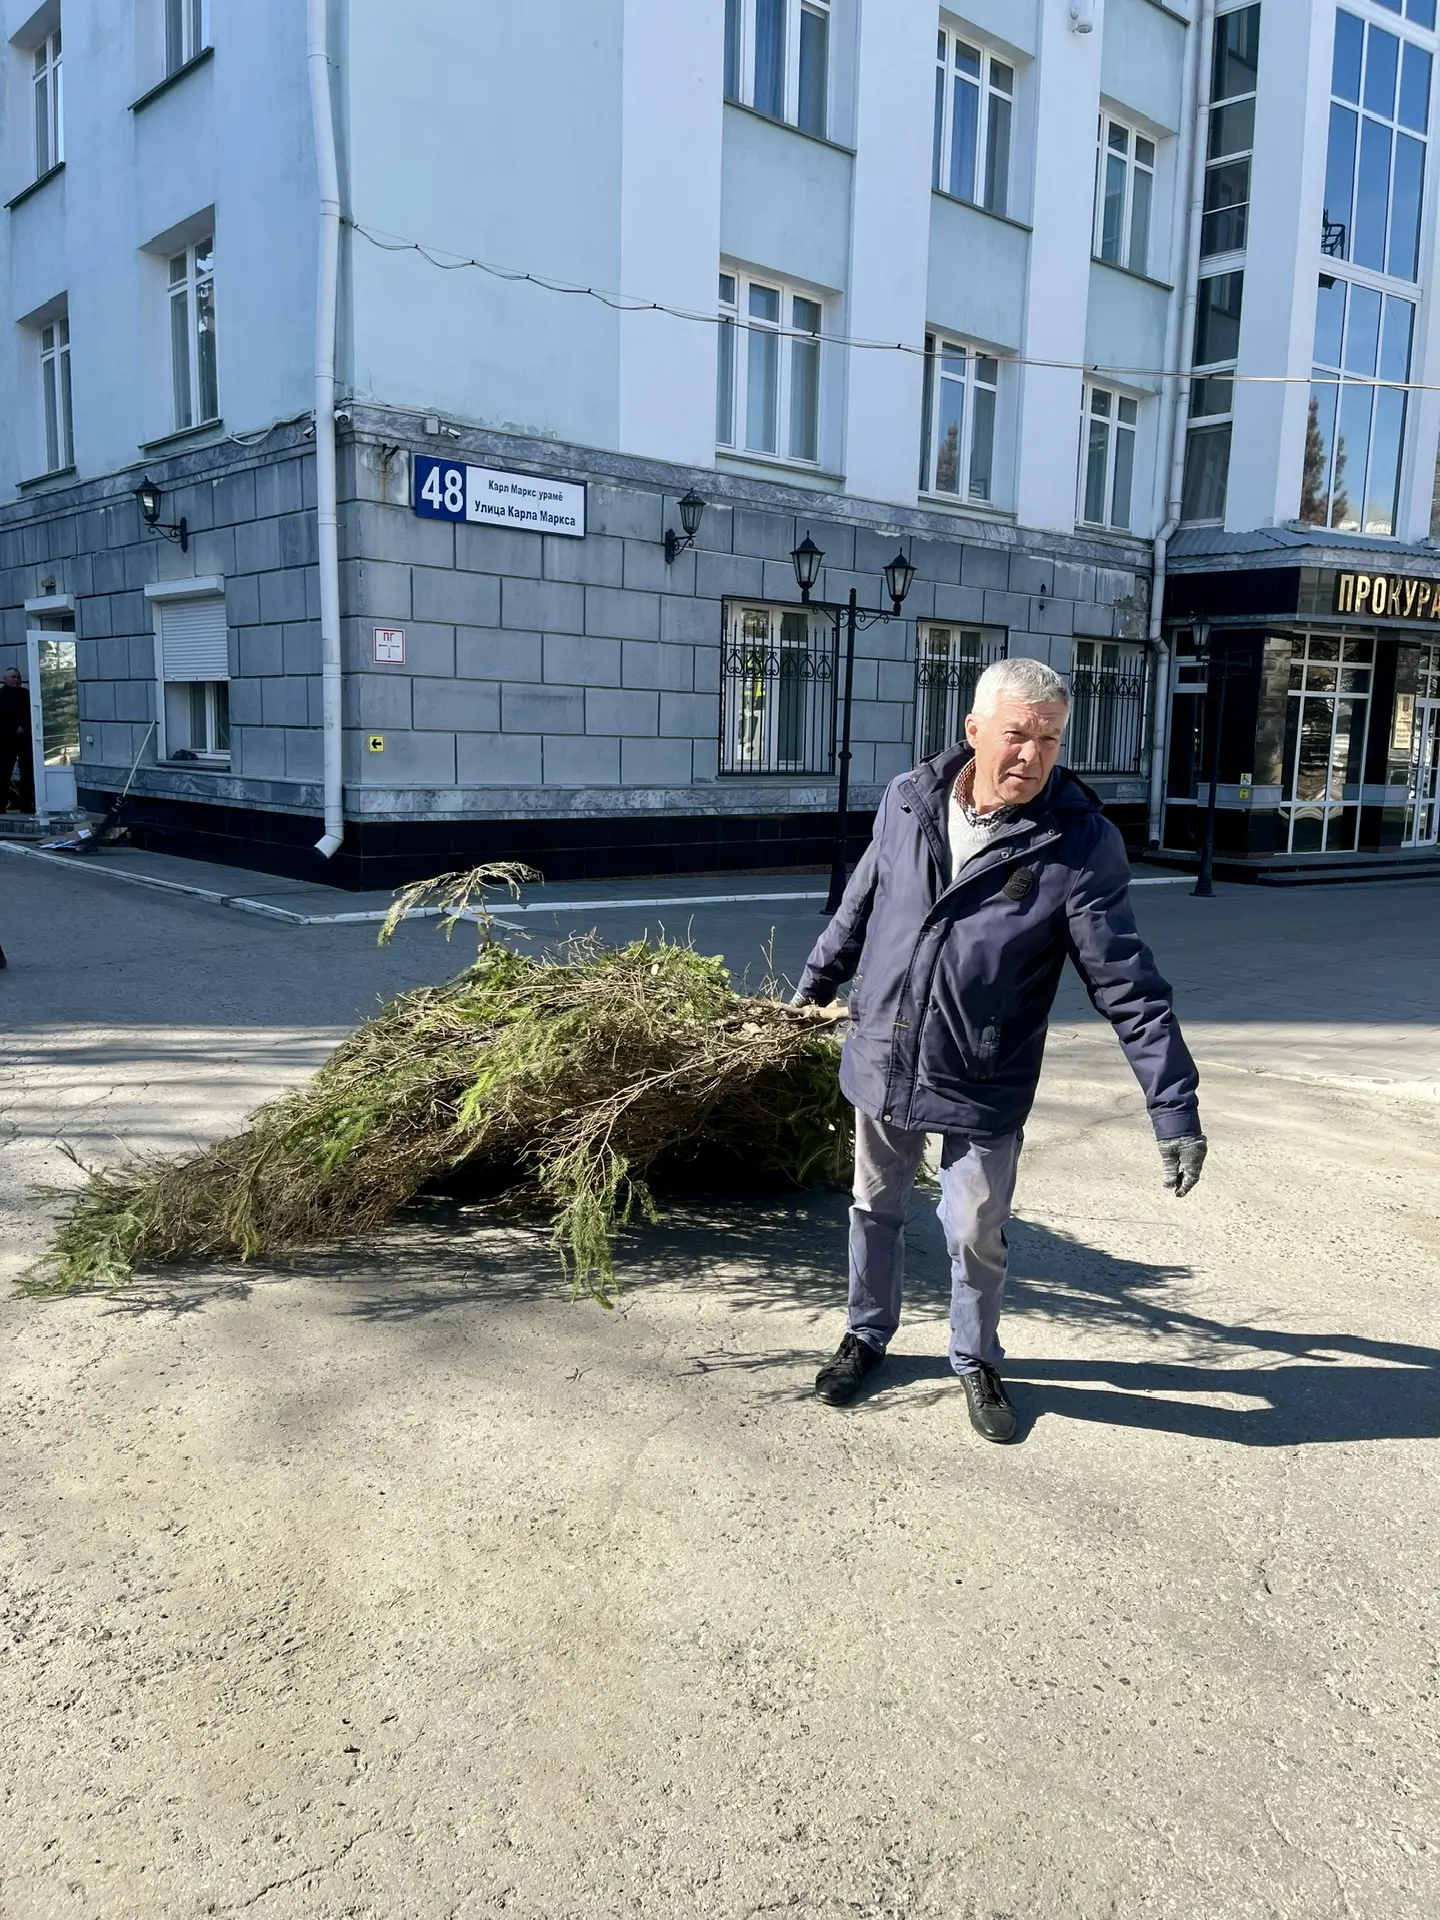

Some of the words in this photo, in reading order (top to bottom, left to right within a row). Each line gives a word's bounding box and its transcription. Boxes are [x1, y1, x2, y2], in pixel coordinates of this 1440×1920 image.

[421, 466, 464, 513] 48
[488, 480, 509, 494] Карл
[511, 483, 537, 497] Маркс
[475, 500, 506, 517] Улица
[508, 505, 538, 521] Карла
[540, 510, 576, 526] Маркса
[383, 633, 394, 642] ПГ
